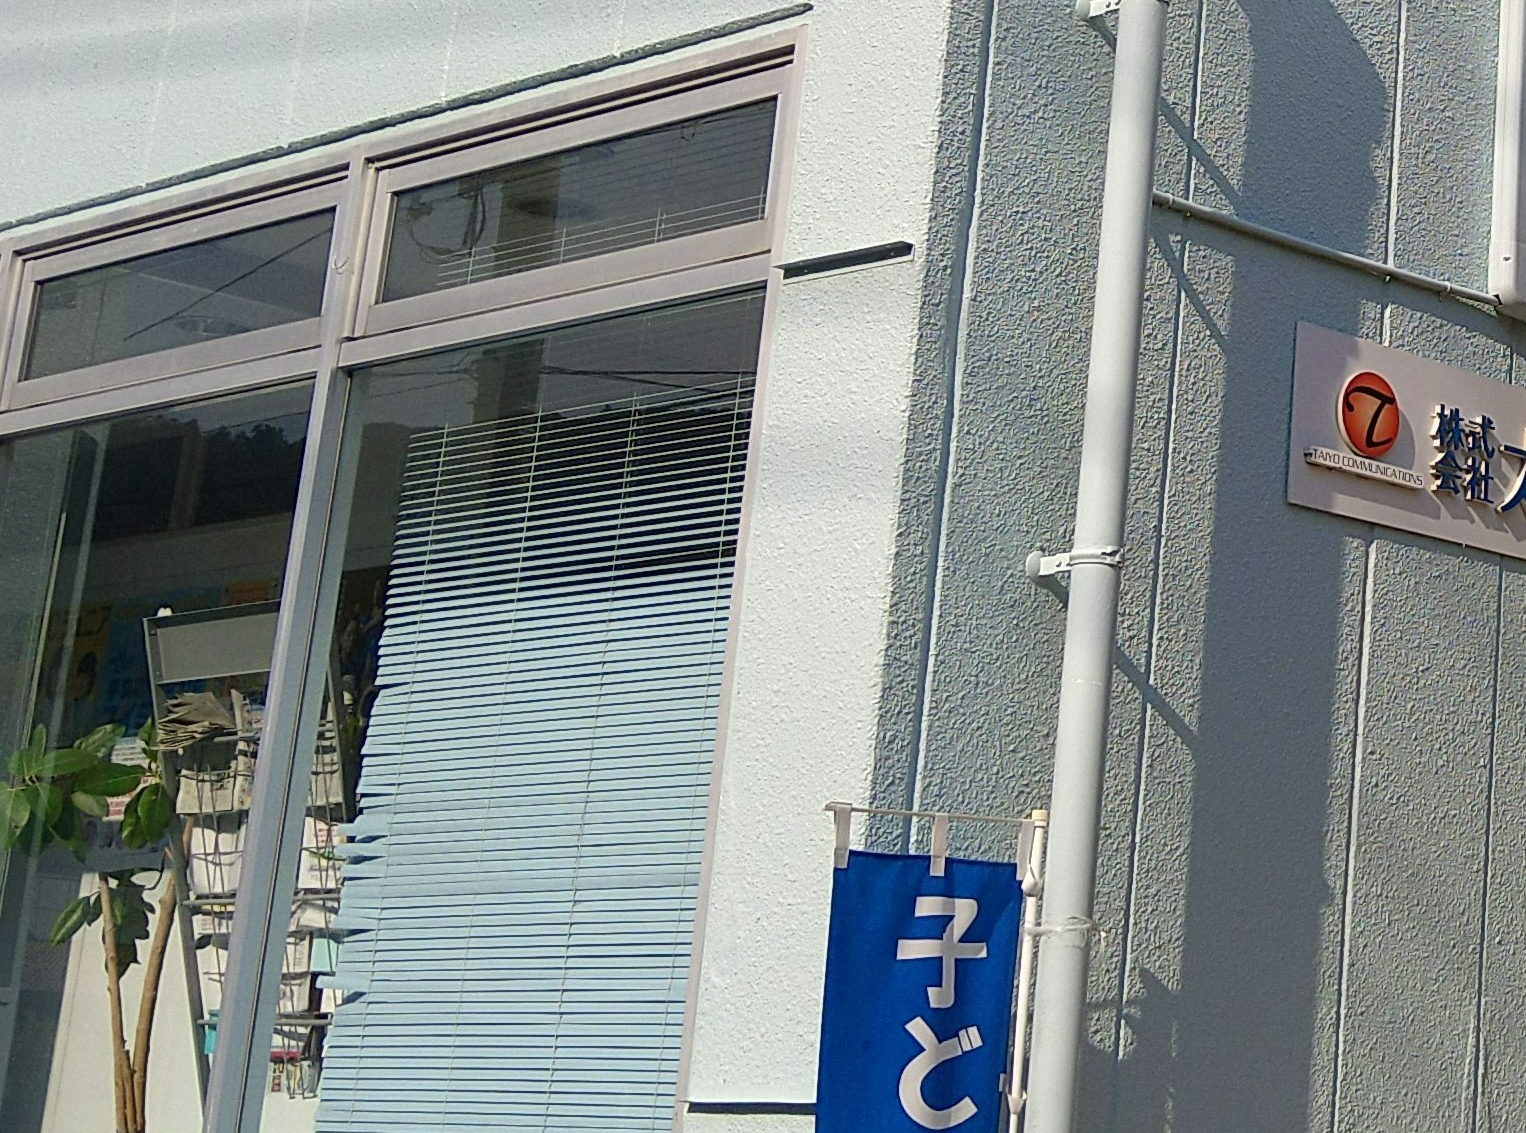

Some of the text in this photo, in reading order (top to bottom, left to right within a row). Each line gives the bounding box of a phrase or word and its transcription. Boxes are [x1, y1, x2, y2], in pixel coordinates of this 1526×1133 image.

[1312, 448, 1423, 486] TAIYO COMMUNICATIONS
[896, 896, 988, 1131] 子ど
